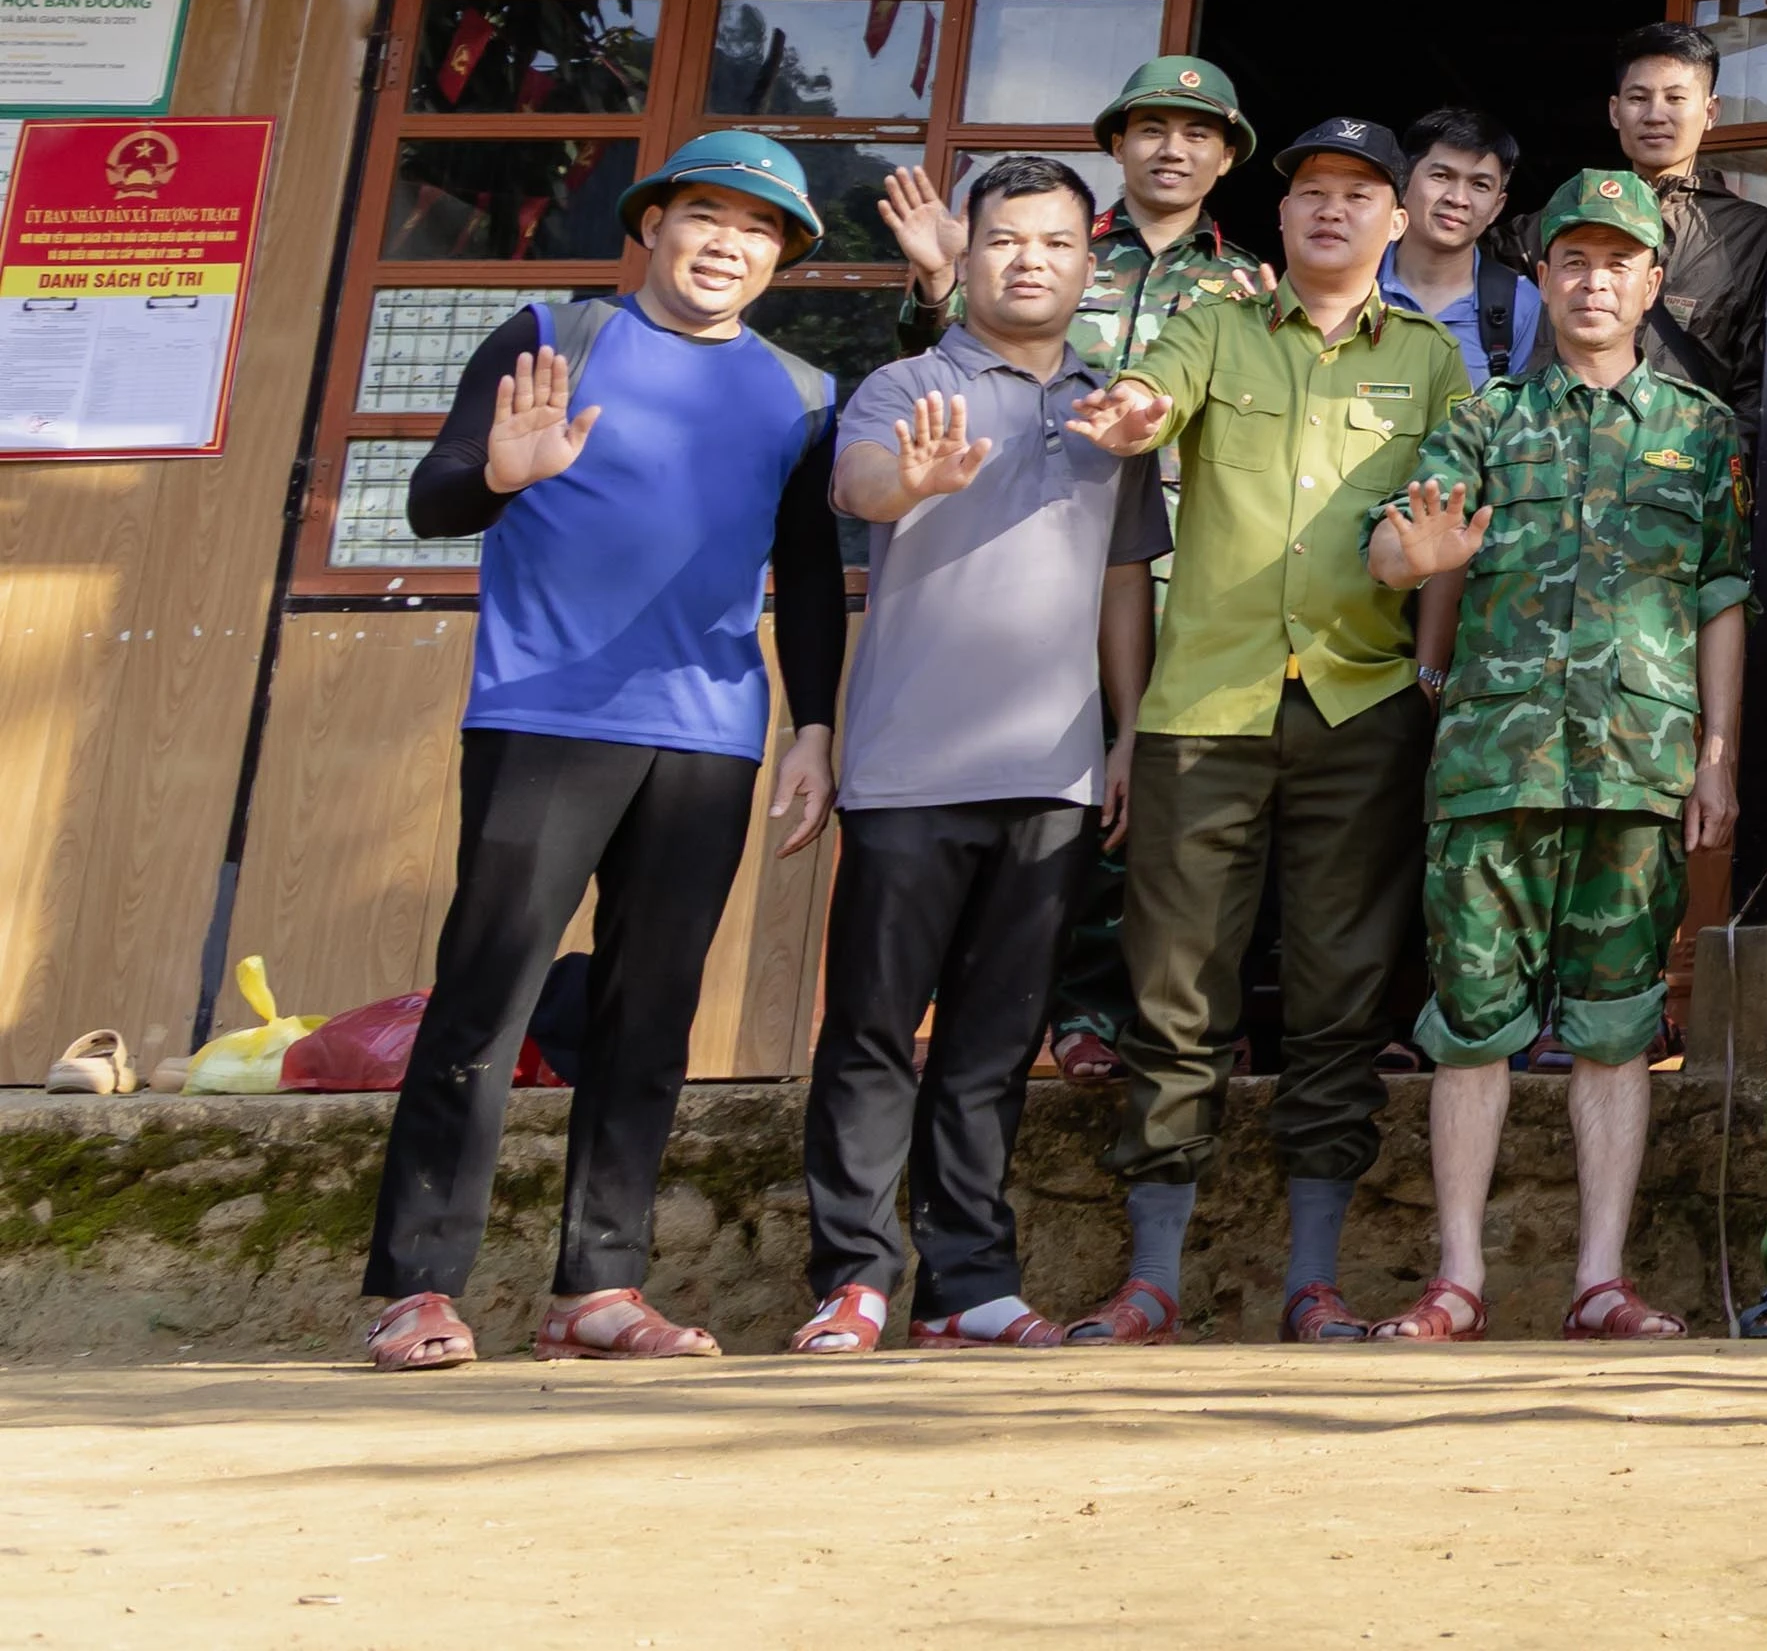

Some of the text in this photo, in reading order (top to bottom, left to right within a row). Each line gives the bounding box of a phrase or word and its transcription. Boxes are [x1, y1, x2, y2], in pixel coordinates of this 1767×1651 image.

[39, 268, 204, 289] DANH SÁCH CỬ TRI
